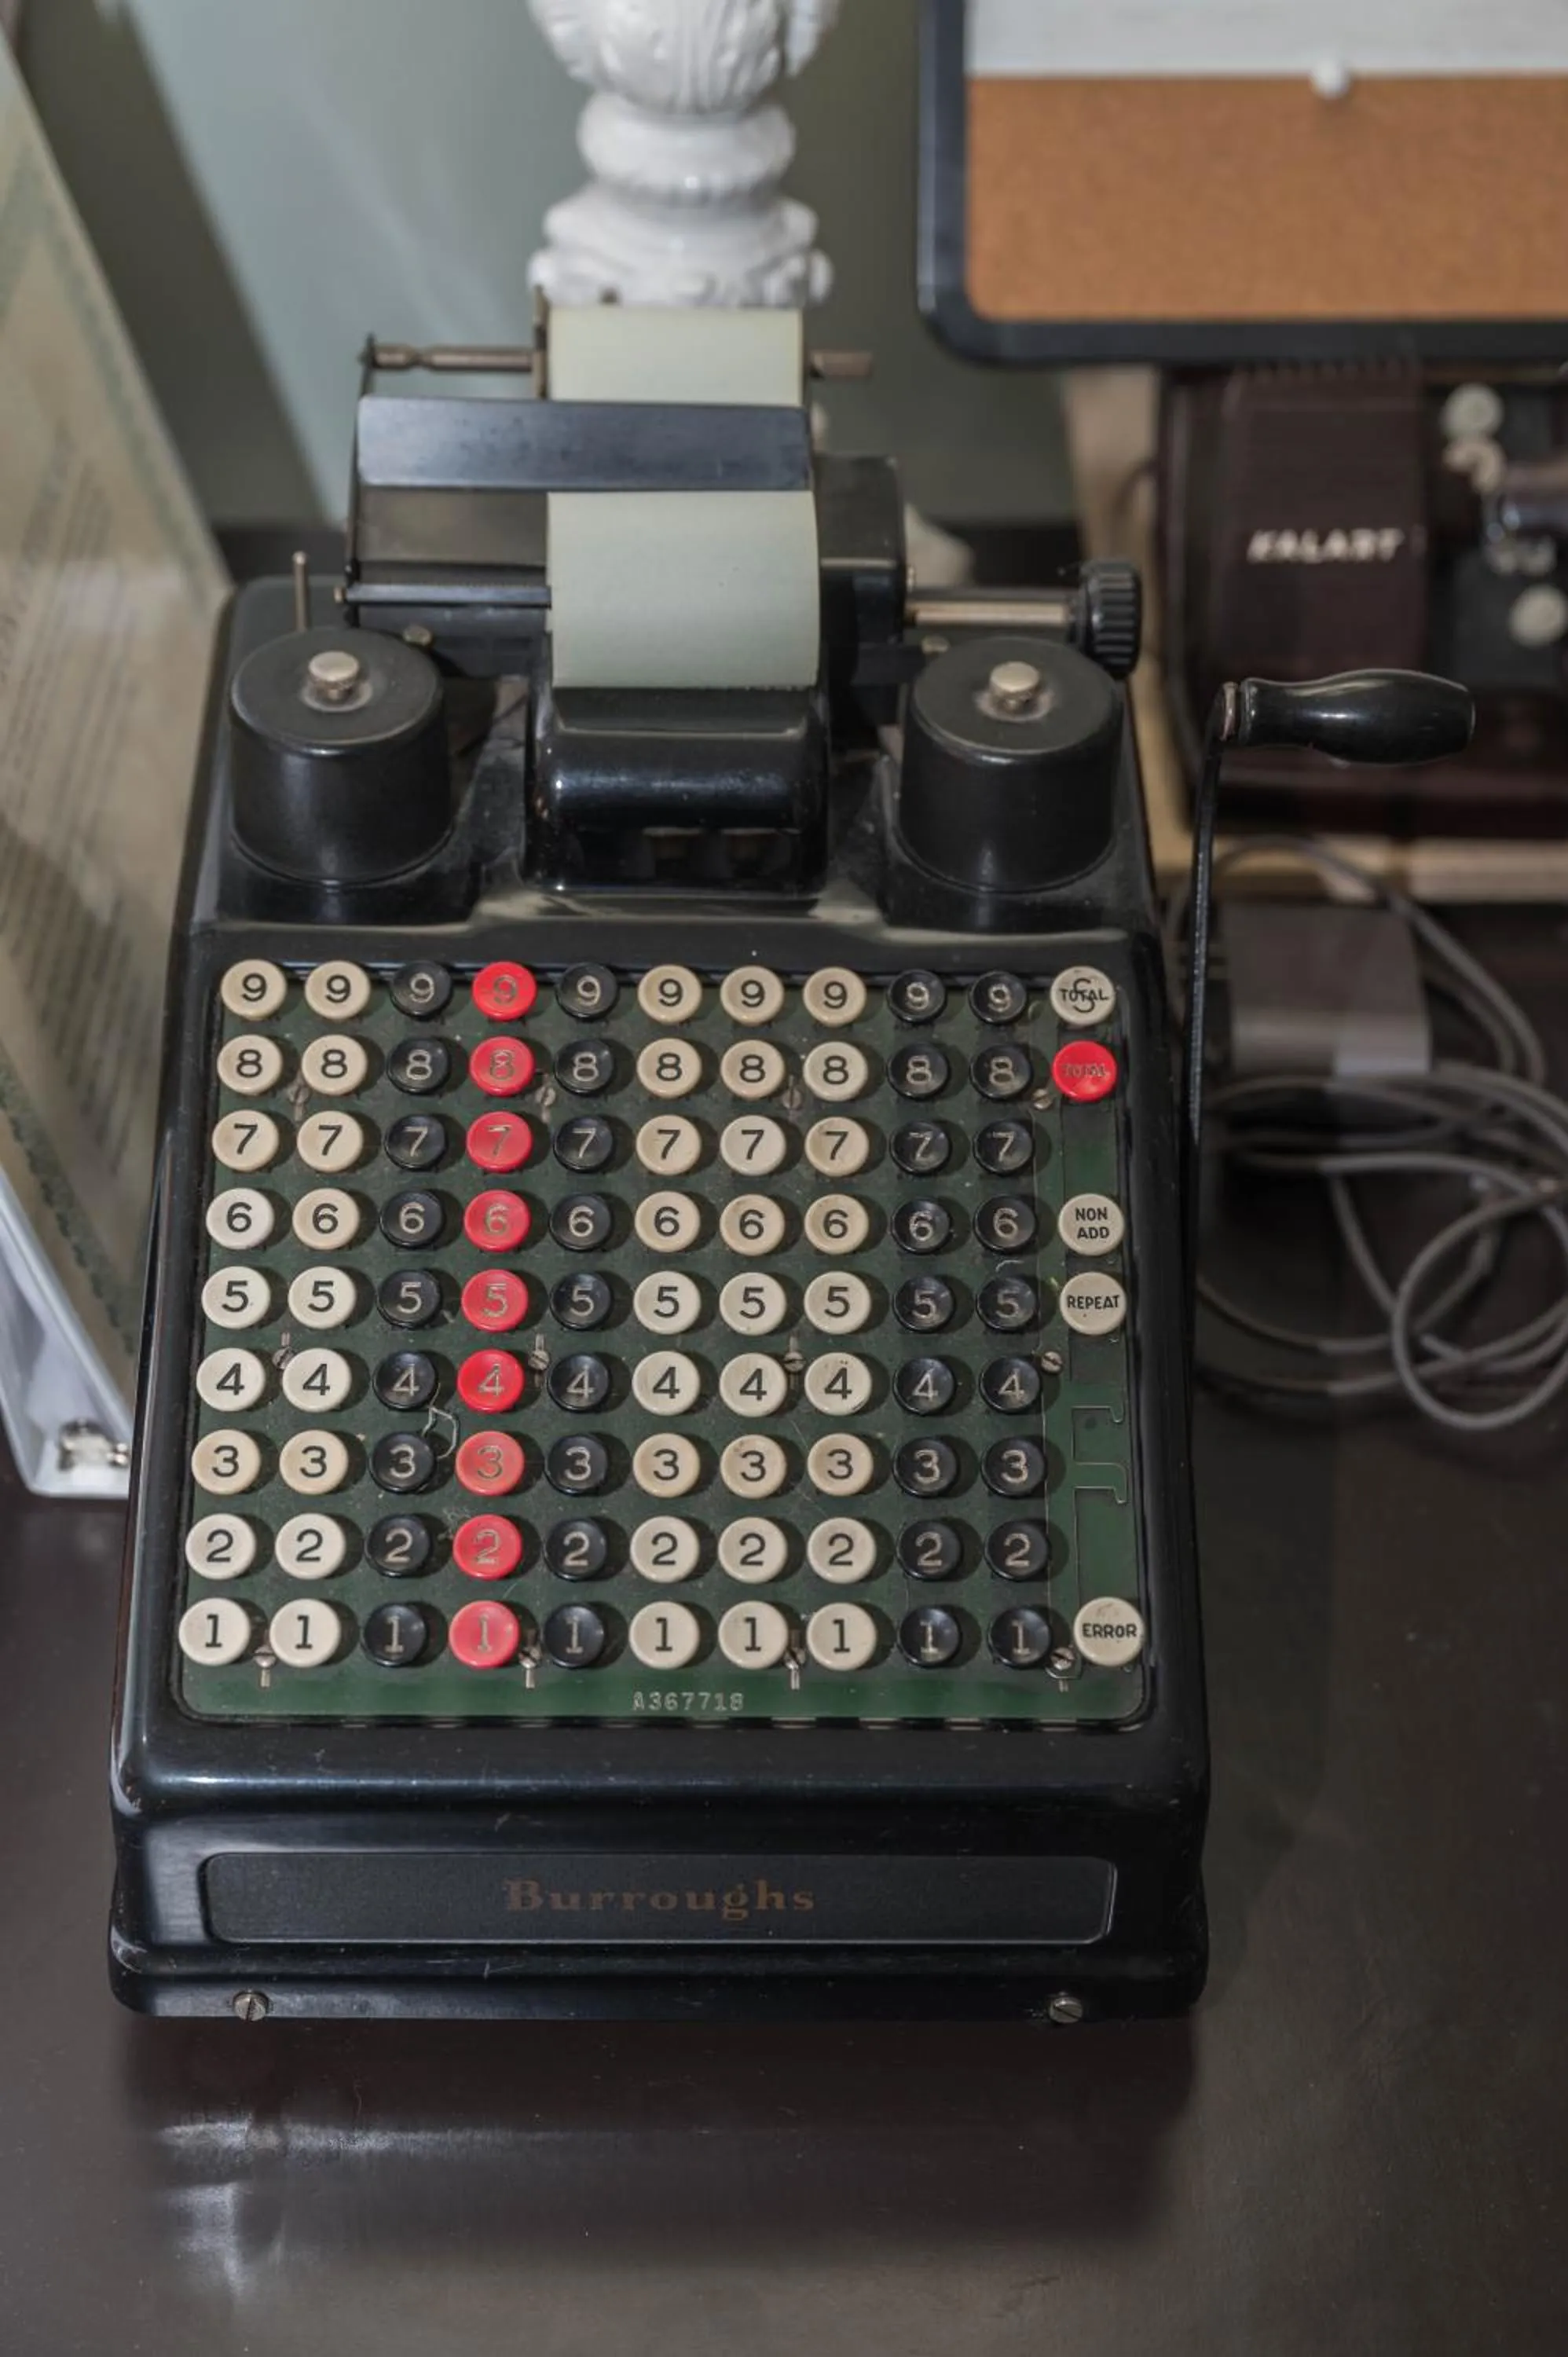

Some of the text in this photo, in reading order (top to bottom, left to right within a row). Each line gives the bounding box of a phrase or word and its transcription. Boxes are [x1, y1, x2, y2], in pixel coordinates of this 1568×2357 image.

[241, 972, 1012, 1011] 9 9 9 9 9 9 9 9 9 9
[1060, 988, 1109, 1002] TOTAL
[236, 1049, 1016, 1085] 8 8 8 8 8 8 8 8 8 8
[1062, 1063, 1108, 1078] TOTAL
[233, 1123, 1016, 1162] 7 7 7 7 7 7 7 7 7 7
[225, 1201, 1019, 1241] 6 6 6 6 6 6 6 6 6 6
[1075, 1207, 1108, 1222] NON
[1077, 1224, 1110, 1239] ADD
[221, 1279, 1020, 1320] 5 5 5 5 5 5 5 5 5 5
[1067, 1296, 1120, 1310] REPEAT
[216, 1362, 1024, 1402] 4 4 4 4 4 4 4 4 4 4
[211, 1444, 1028, 1484] 3 3 3 3 3 3 3 3 3 3
[205, 1528, 1031, 1567] 2 2 2 2 2 2 2 2 2 2
[203, 1614, 1030, 1655] 1 1 1 1 1 1 1 1 1 1
[1082, 1622, 1138, 1638] ERROR
[632, 1691, 745, 1711] A367718
[503, 1879, 815, 1920] Burroughs
